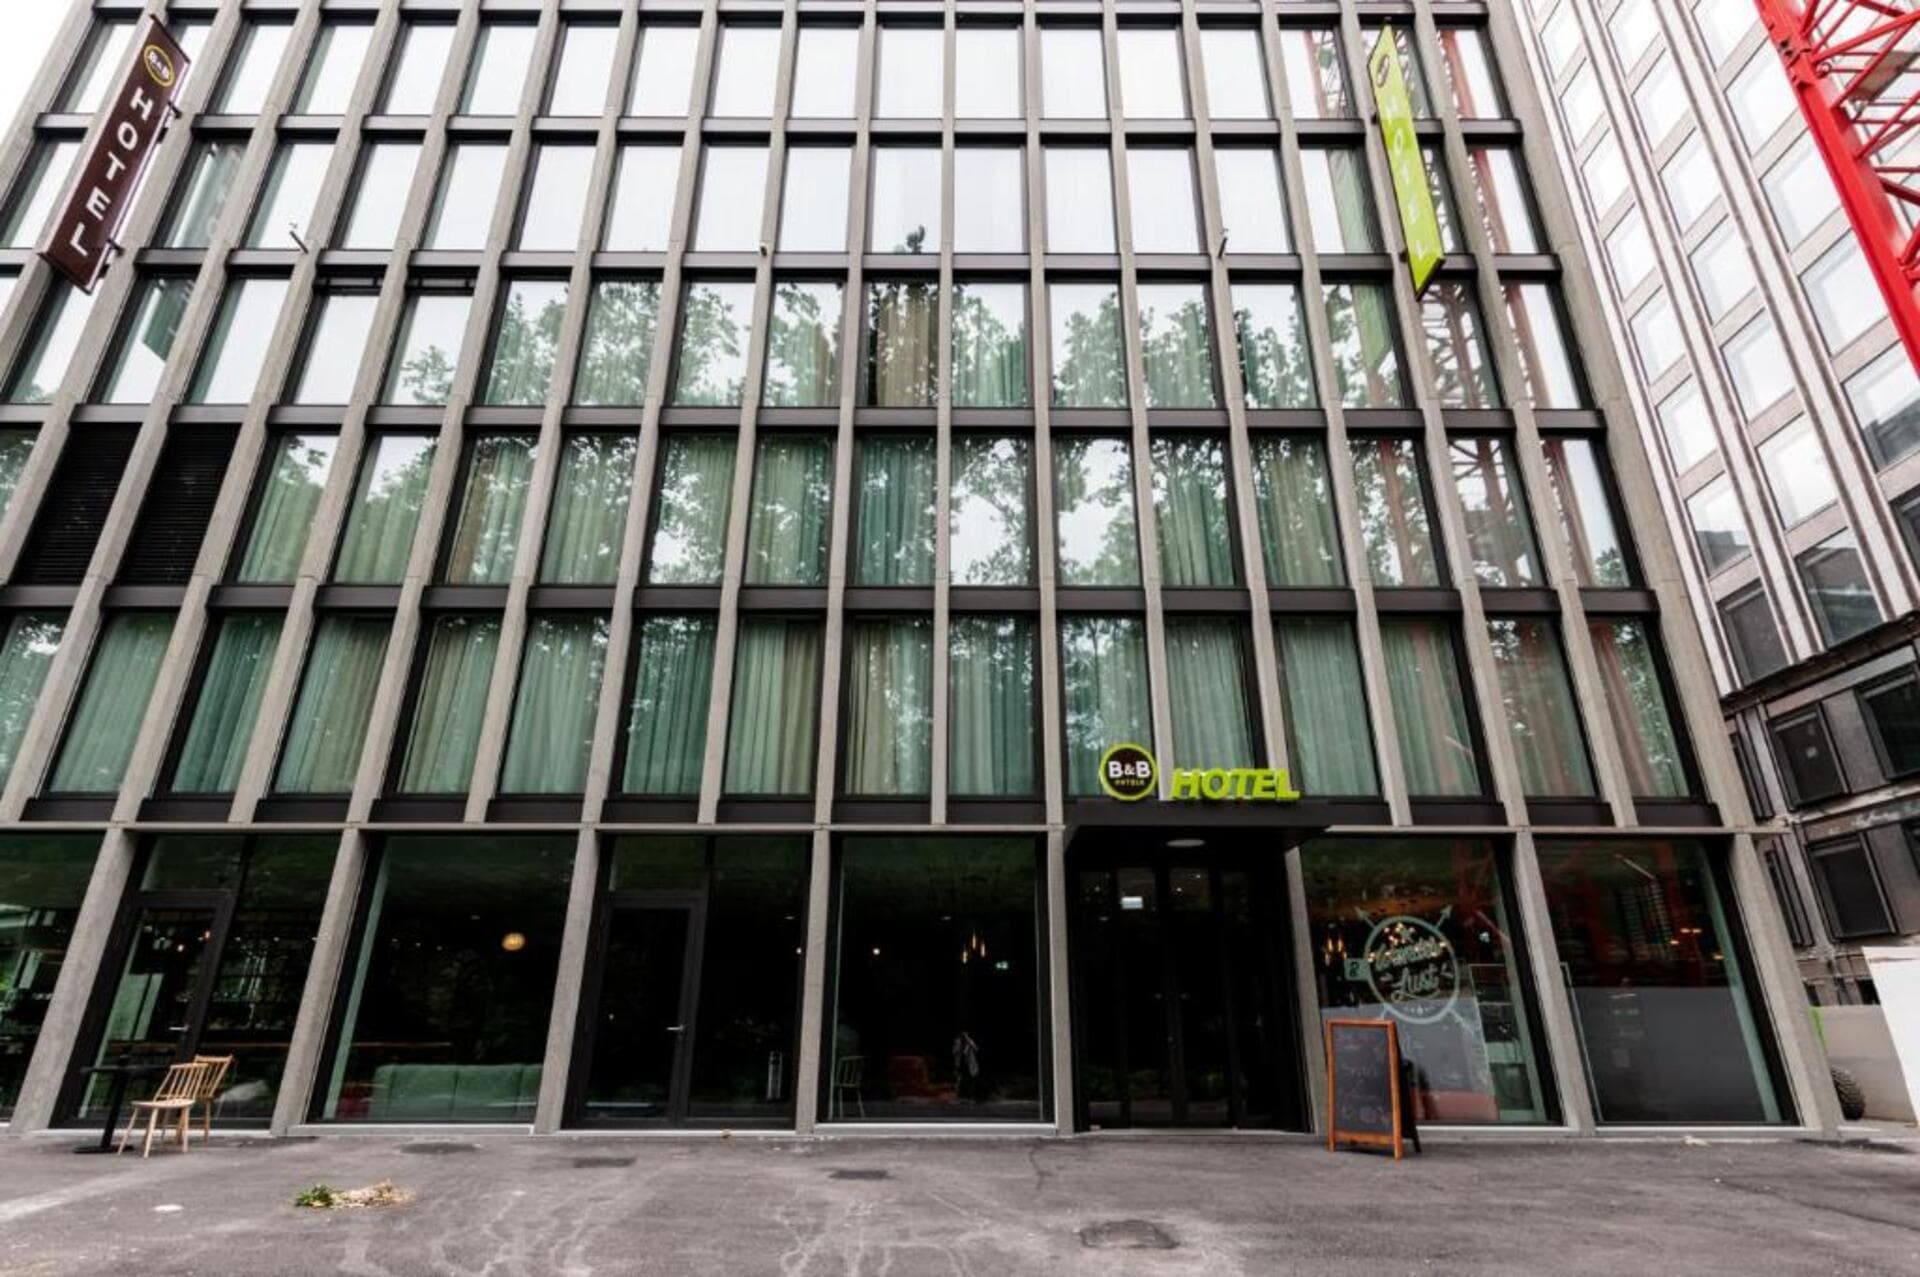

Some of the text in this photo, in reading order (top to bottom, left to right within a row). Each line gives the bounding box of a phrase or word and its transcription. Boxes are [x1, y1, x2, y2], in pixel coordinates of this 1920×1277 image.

[70, 87, 153, 257] HOTEL
[1108, 760, 1151, 778] B&B
[1170, 767, 1301, 800] HOTEL
